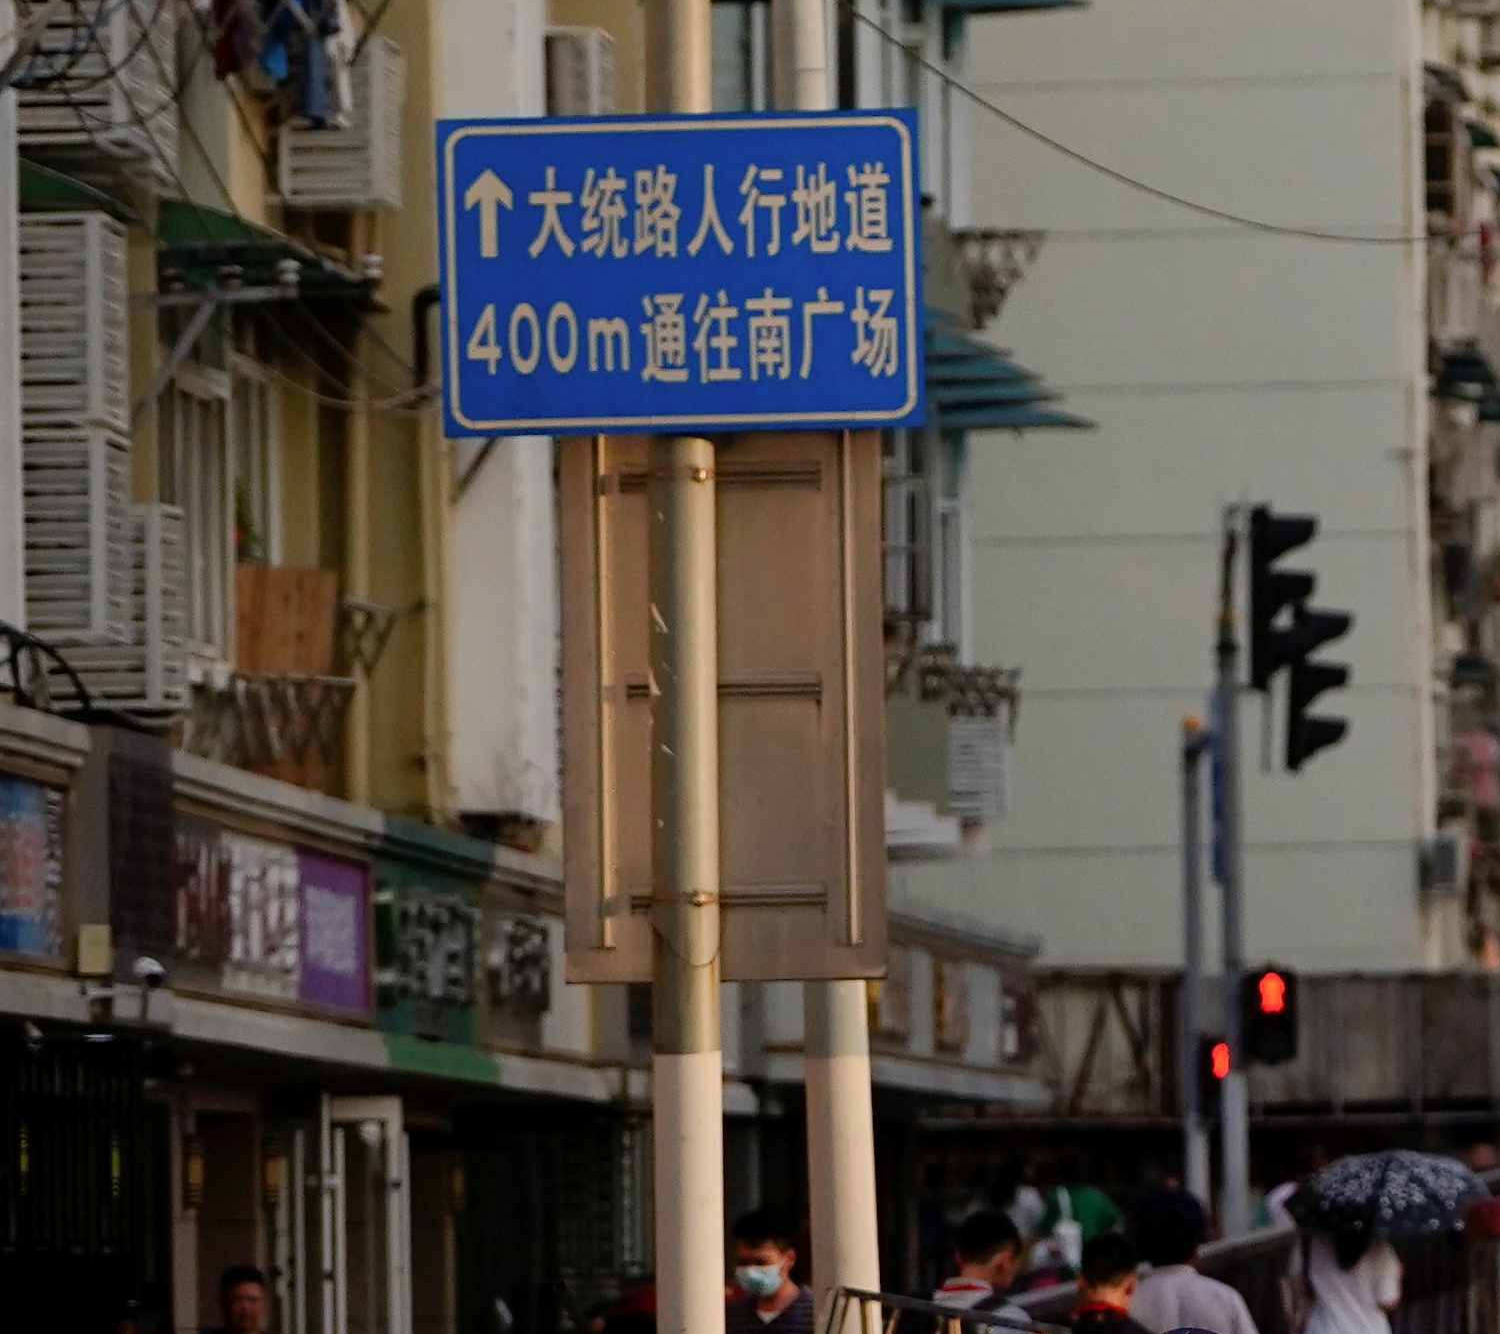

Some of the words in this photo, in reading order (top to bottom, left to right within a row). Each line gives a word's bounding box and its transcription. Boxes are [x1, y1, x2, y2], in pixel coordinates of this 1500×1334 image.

[528, 162, 894, 259] 大统路人行地道
